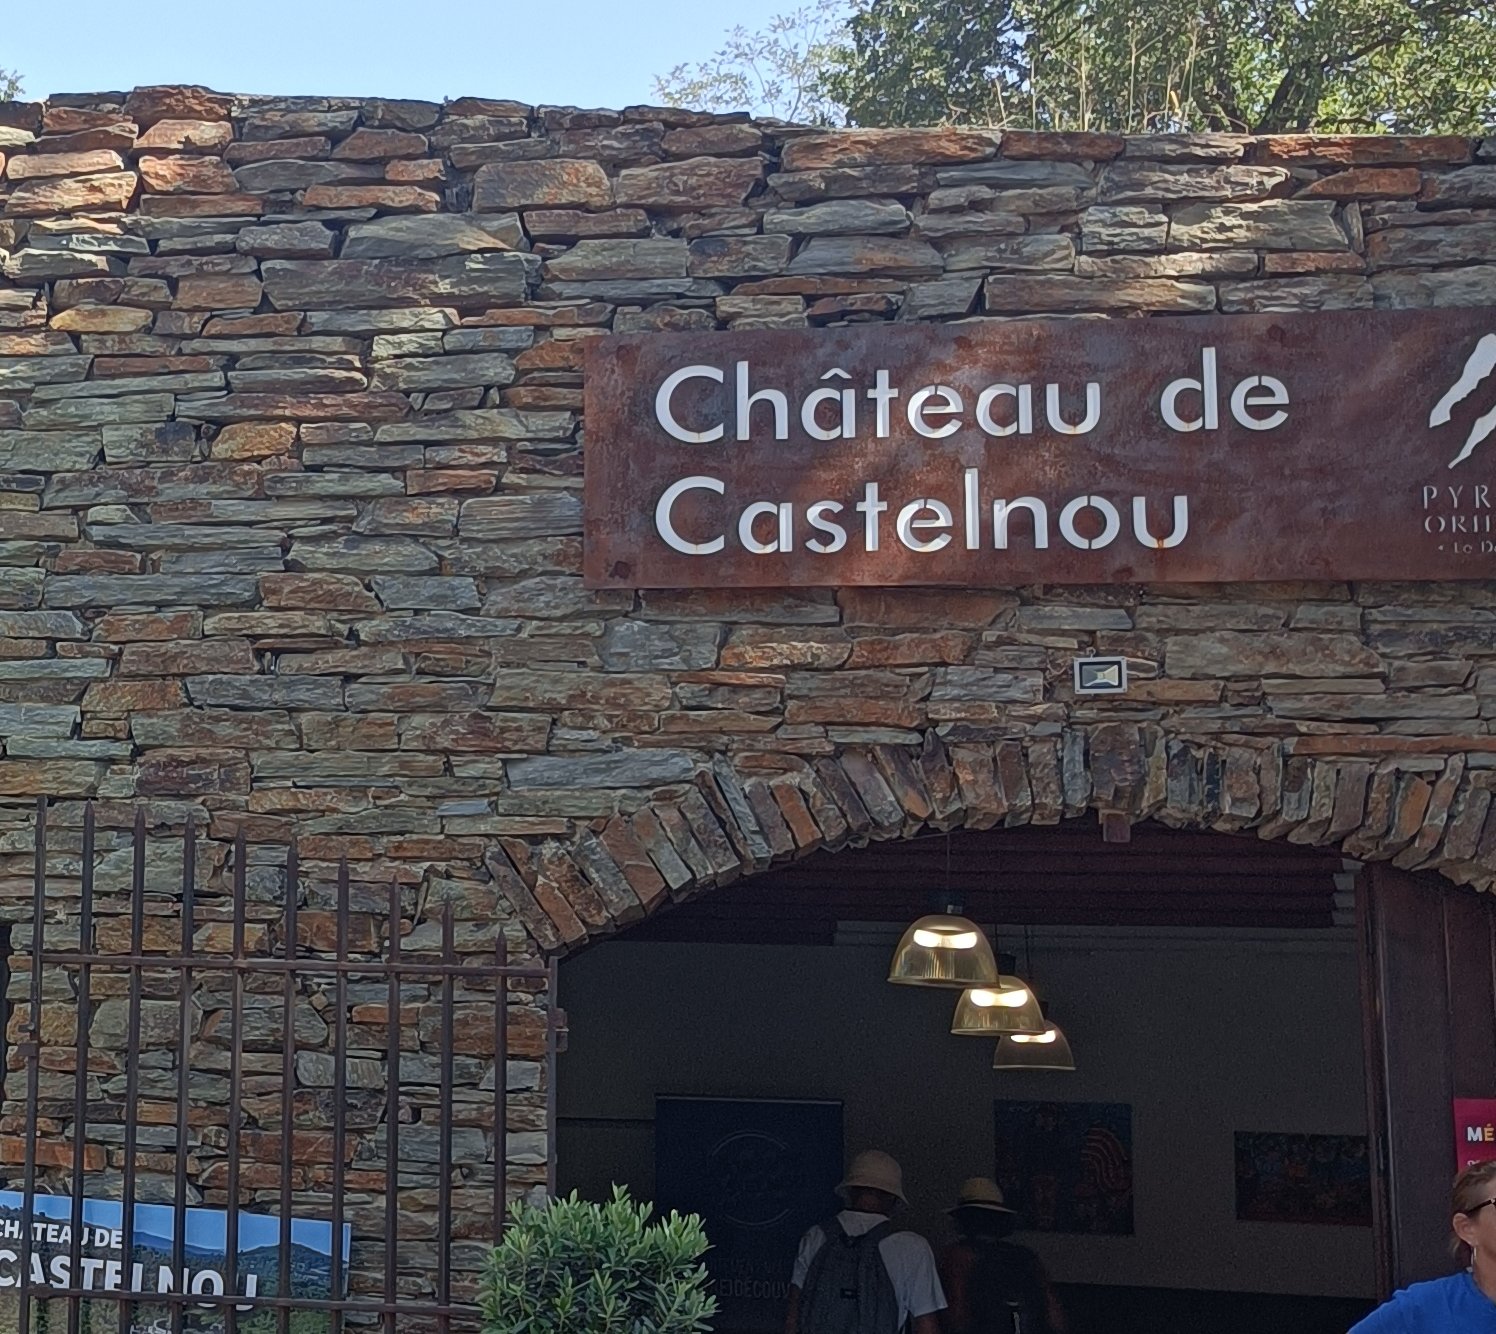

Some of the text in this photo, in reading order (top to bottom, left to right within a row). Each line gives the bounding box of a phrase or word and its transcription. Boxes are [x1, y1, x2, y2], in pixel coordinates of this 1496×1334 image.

[655, 346, 1290, 444] Château de
[655, 467, 1190, 555] Castelnou
[94, 1228, 123, 1249] DE
